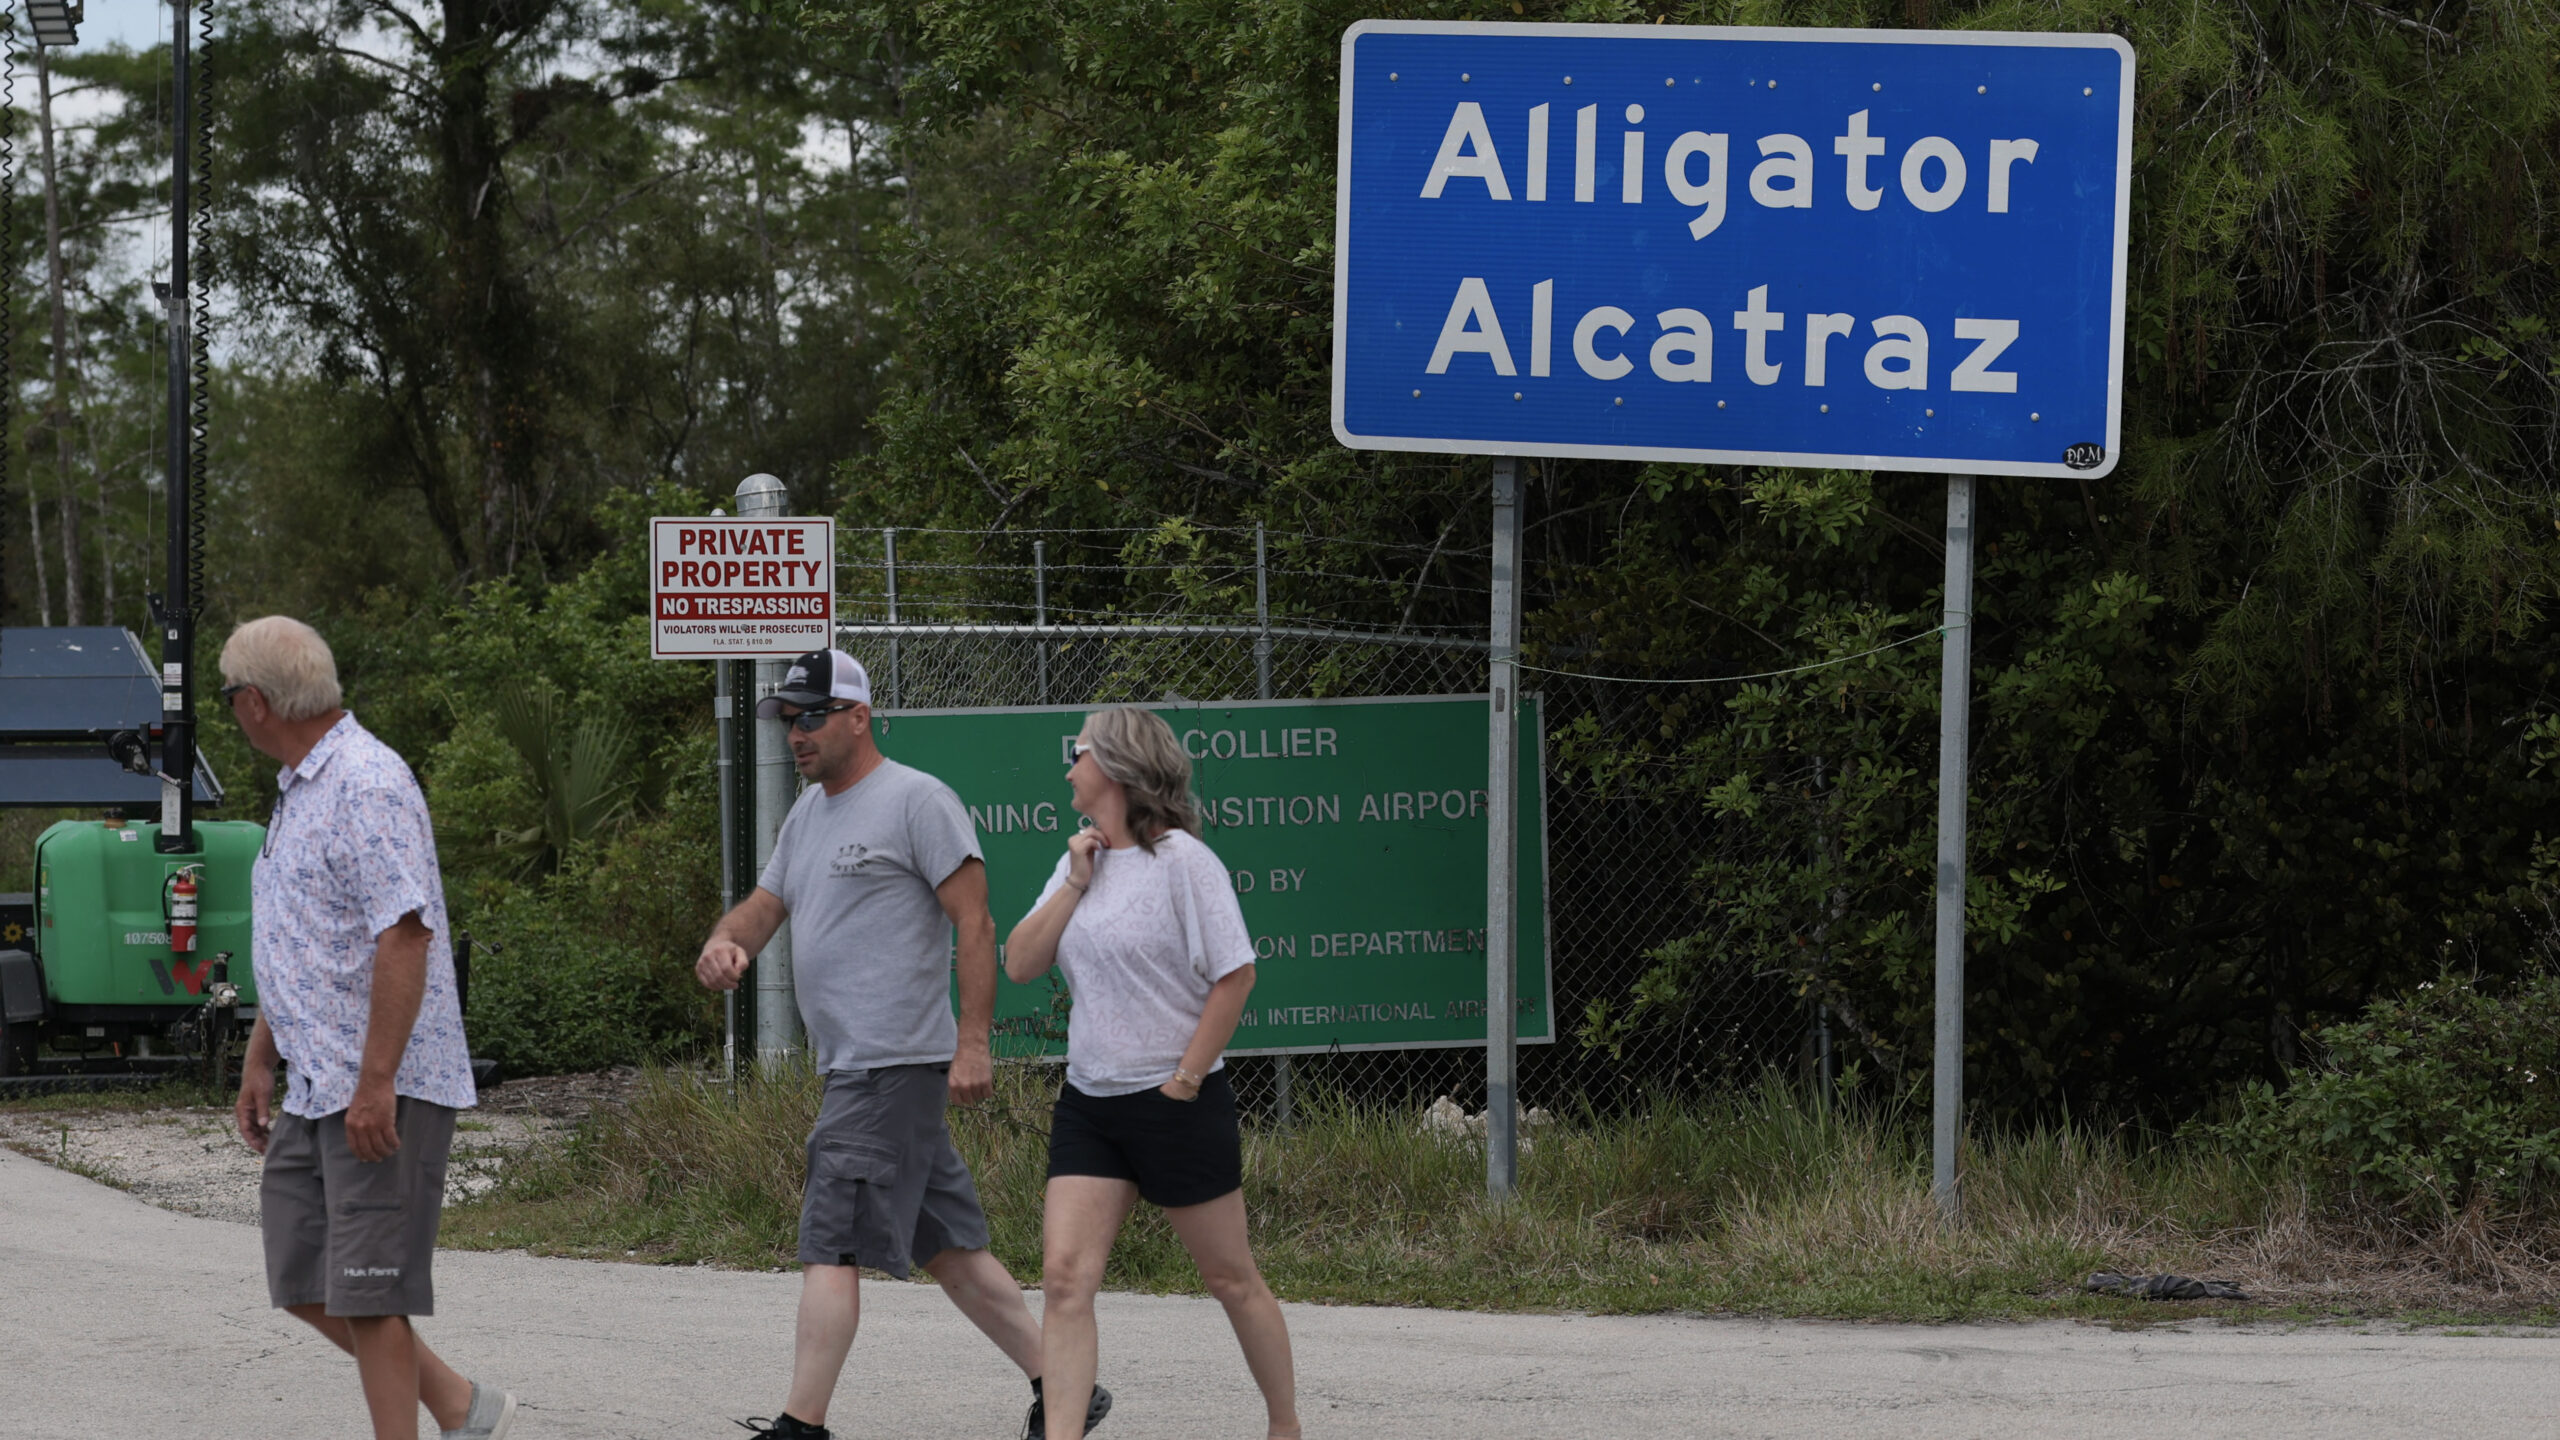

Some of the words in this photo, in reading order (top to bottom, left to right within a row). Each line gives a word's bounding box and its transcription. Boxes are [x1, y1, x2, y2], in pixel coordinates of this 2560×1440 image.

[1419, 101, 2039, 241] Alligator
[1425, 276, 2020, 393] Alcatraz
[679, 529, 805, 555] PRIVATE
[662, 561, 822, 587] PROPERTY
[662, 598, 690, 615] NO
[694, 597, 824, 615] TRESPASSING
[663, 625, 717, 634] VIOLATORS
[719, 625, 741, 634] WILL
[744, 624, 757, 634] BE
[759, 624, 824, 634] PROSECUTED
[713, 638, 727, 646] FLA.
[728, 638, 745, 646] STAT.
[752, 638, 773, 646] 810.09
[1182, 727, 1338, 760] COLLIER
[969, 801, 1058, 833] NING
[1196, 794, 1340, 828] NSITION
[1358, 789, 1489, 823] AIRPOR
[1270, 867, 1307, 892] BY
[1310, 928, 1487, 958] DEPARTMEN
[1267, 1002, 1436, 1026] INTERNATIONAL
